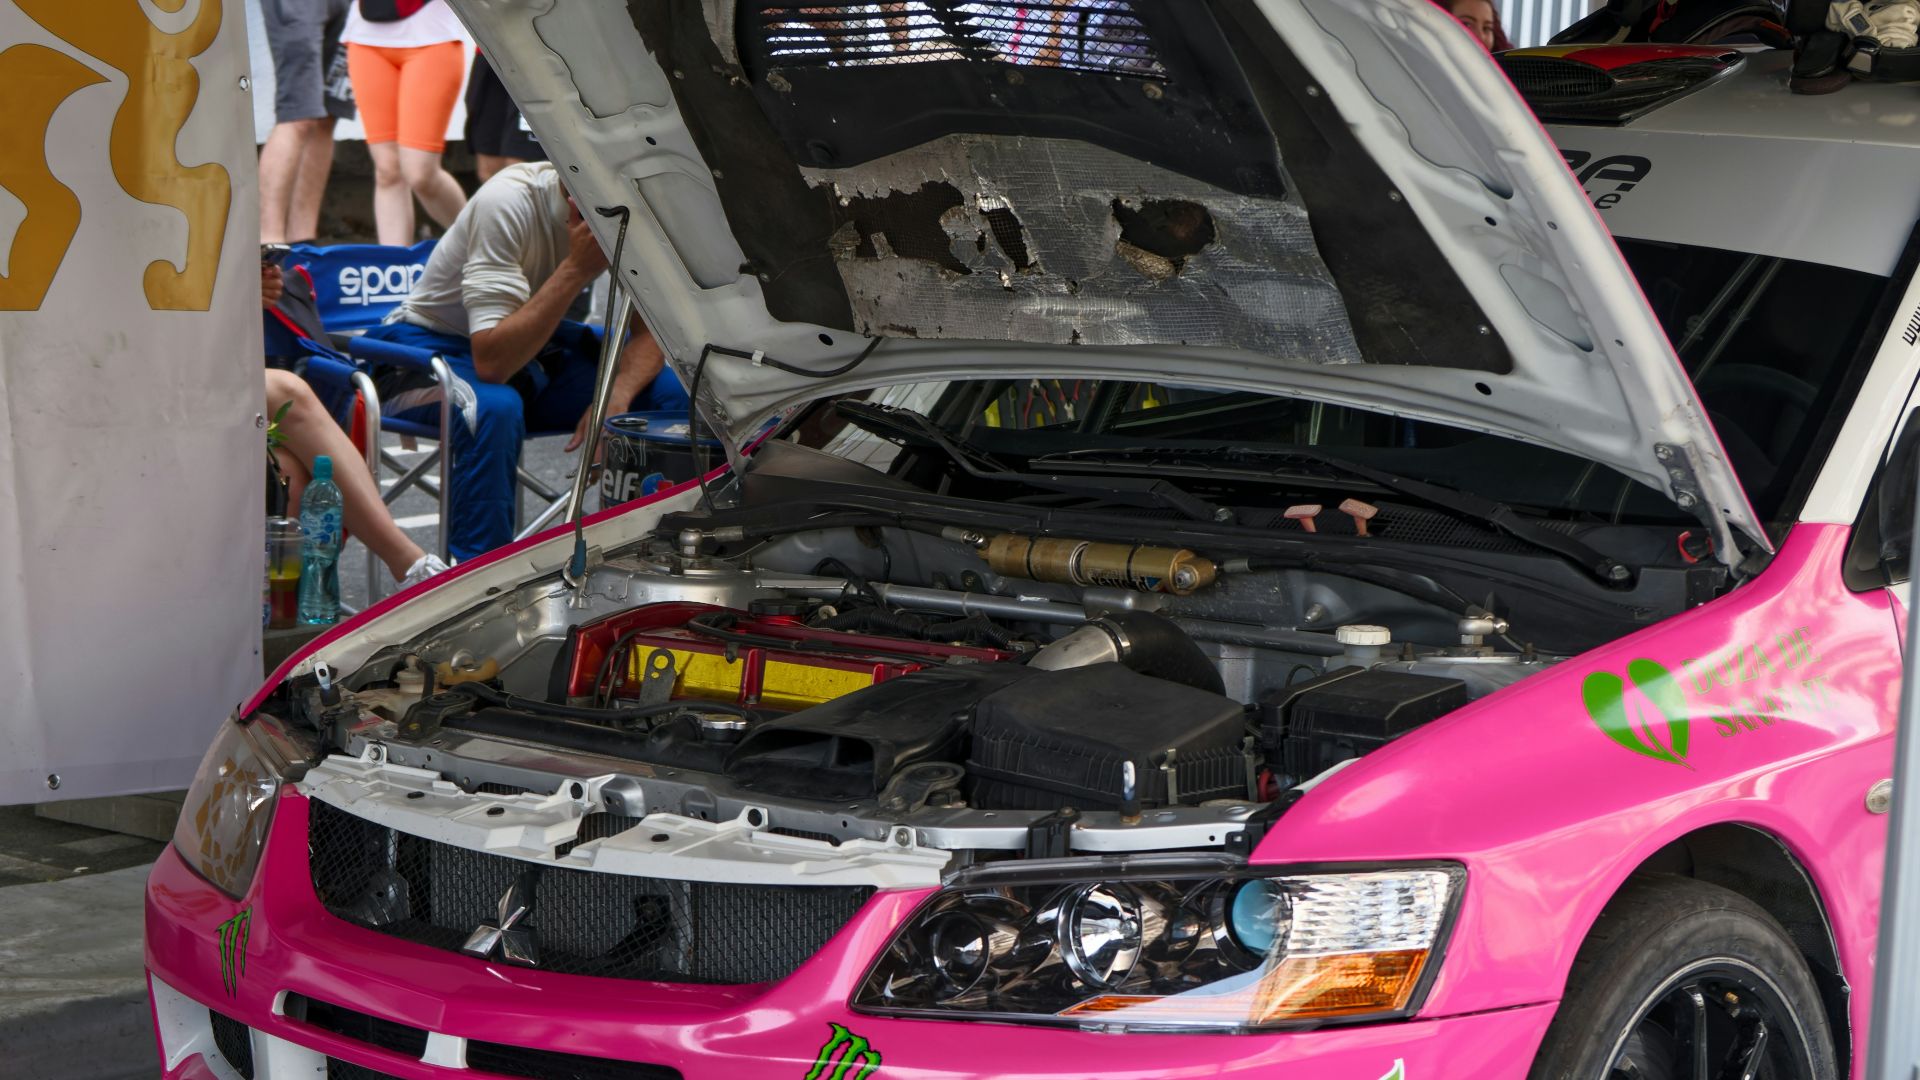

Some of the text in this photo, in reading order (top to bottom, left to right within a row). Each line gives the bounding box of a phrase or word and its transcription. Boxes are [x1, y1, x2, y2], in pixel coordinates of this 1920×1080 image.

[602, 469, 639, 501] elf
[1681, 626, 1822, 695] DOZA DE
